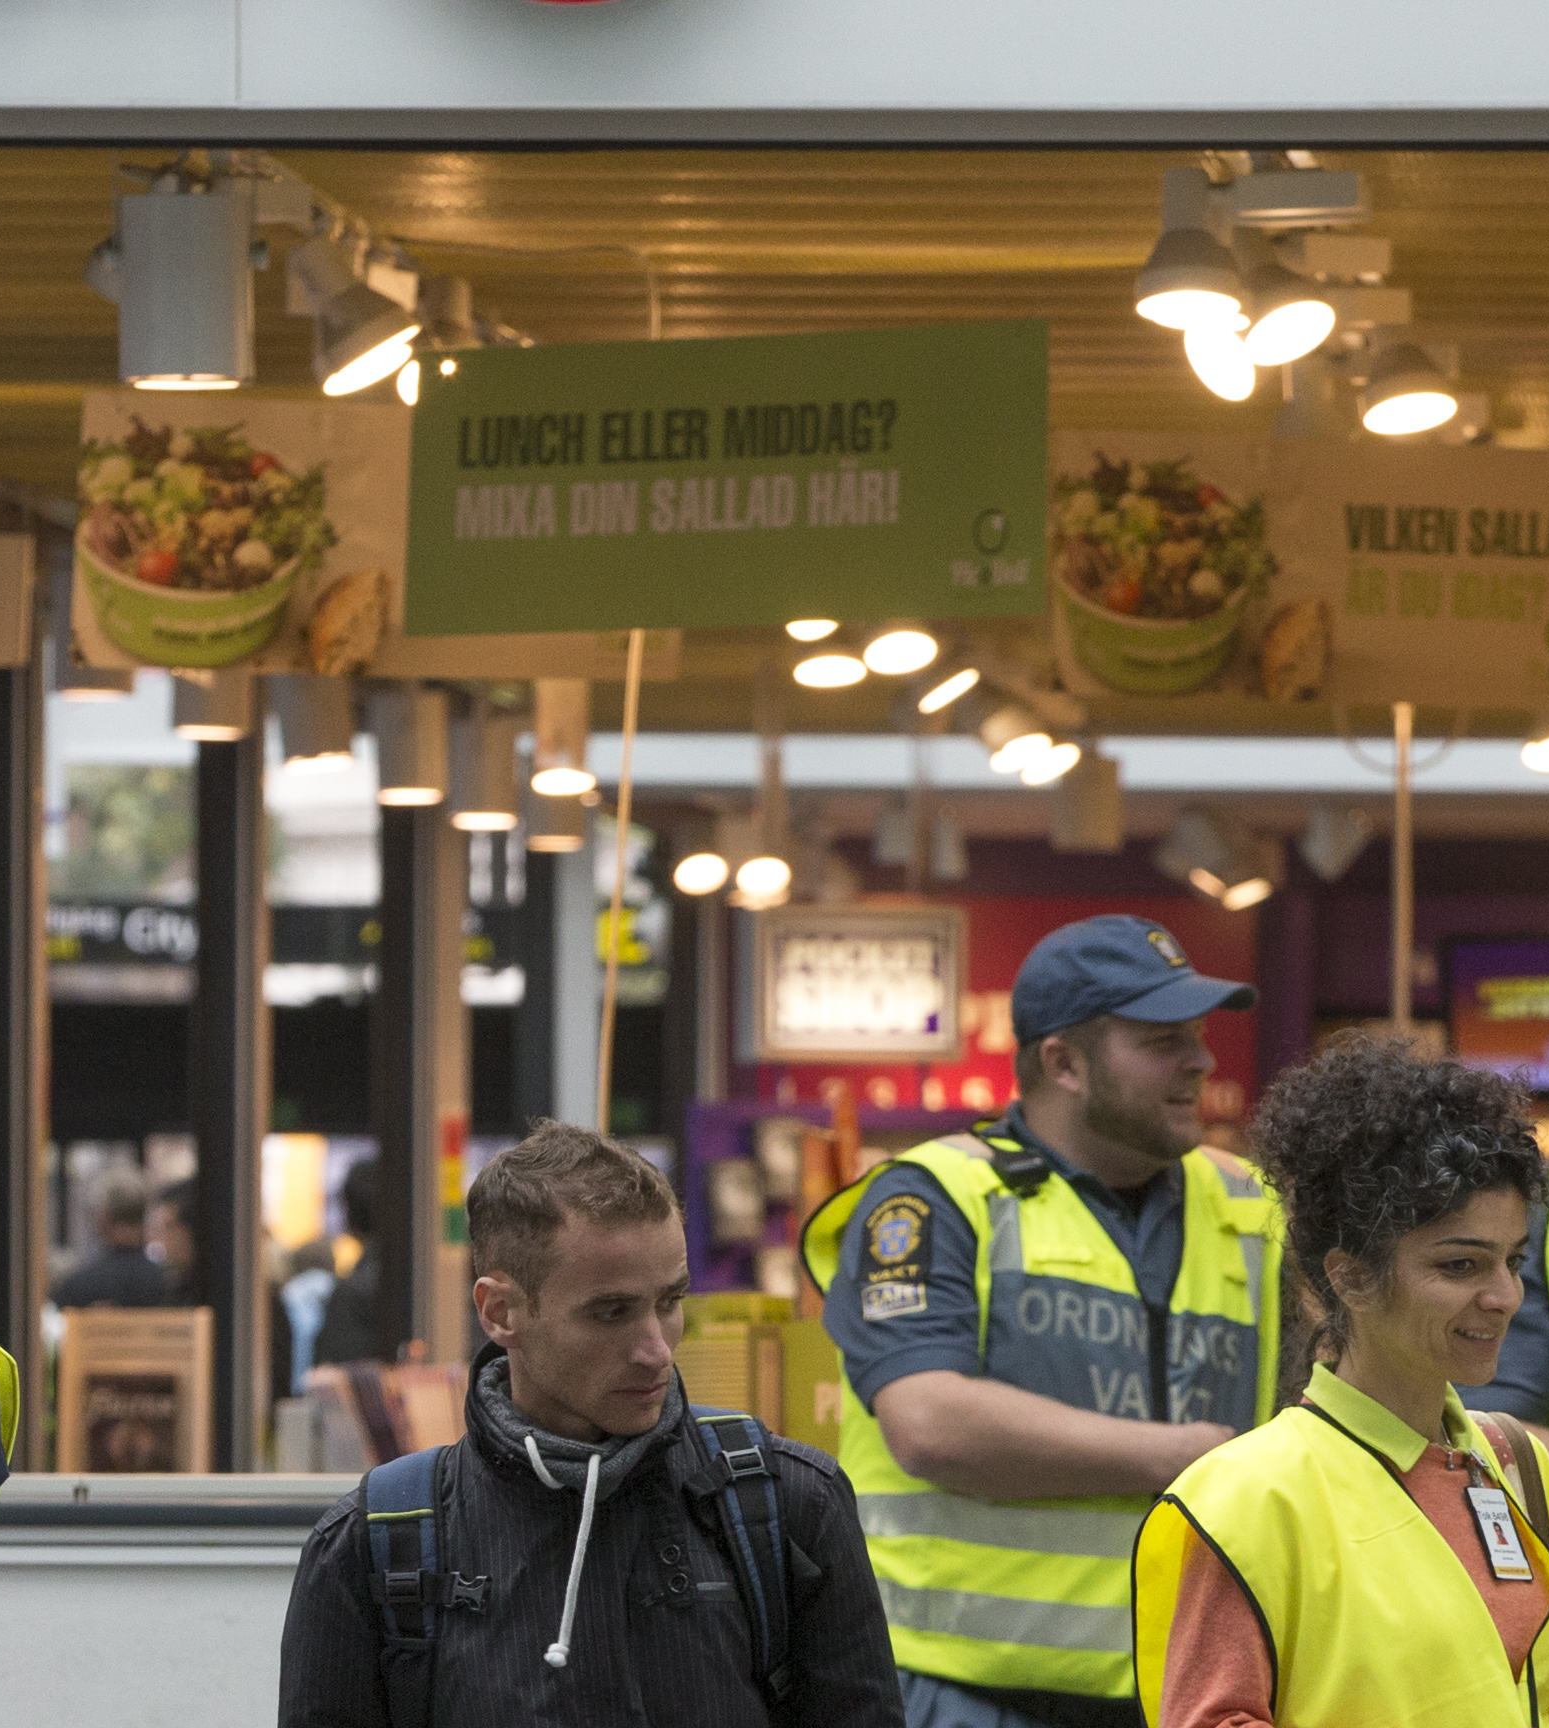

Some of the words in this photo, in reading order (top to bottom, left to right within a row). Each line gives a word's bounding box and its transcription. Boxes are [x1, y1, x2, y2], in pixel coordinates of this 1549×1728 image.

[458, 412, 585, 470] LUNCH
[600, 408, 710, 463] ELLER
[722, 398, 898, 459] MIDDAG?
[454, 482, 557, 540] MIXA
[569, 479, 639, 536] DIN
[651, 474, 796, 533] SALLAD
[808, 456, 900, 527] HÄR!
[1346, 504, 1458, 555] VILKEN
